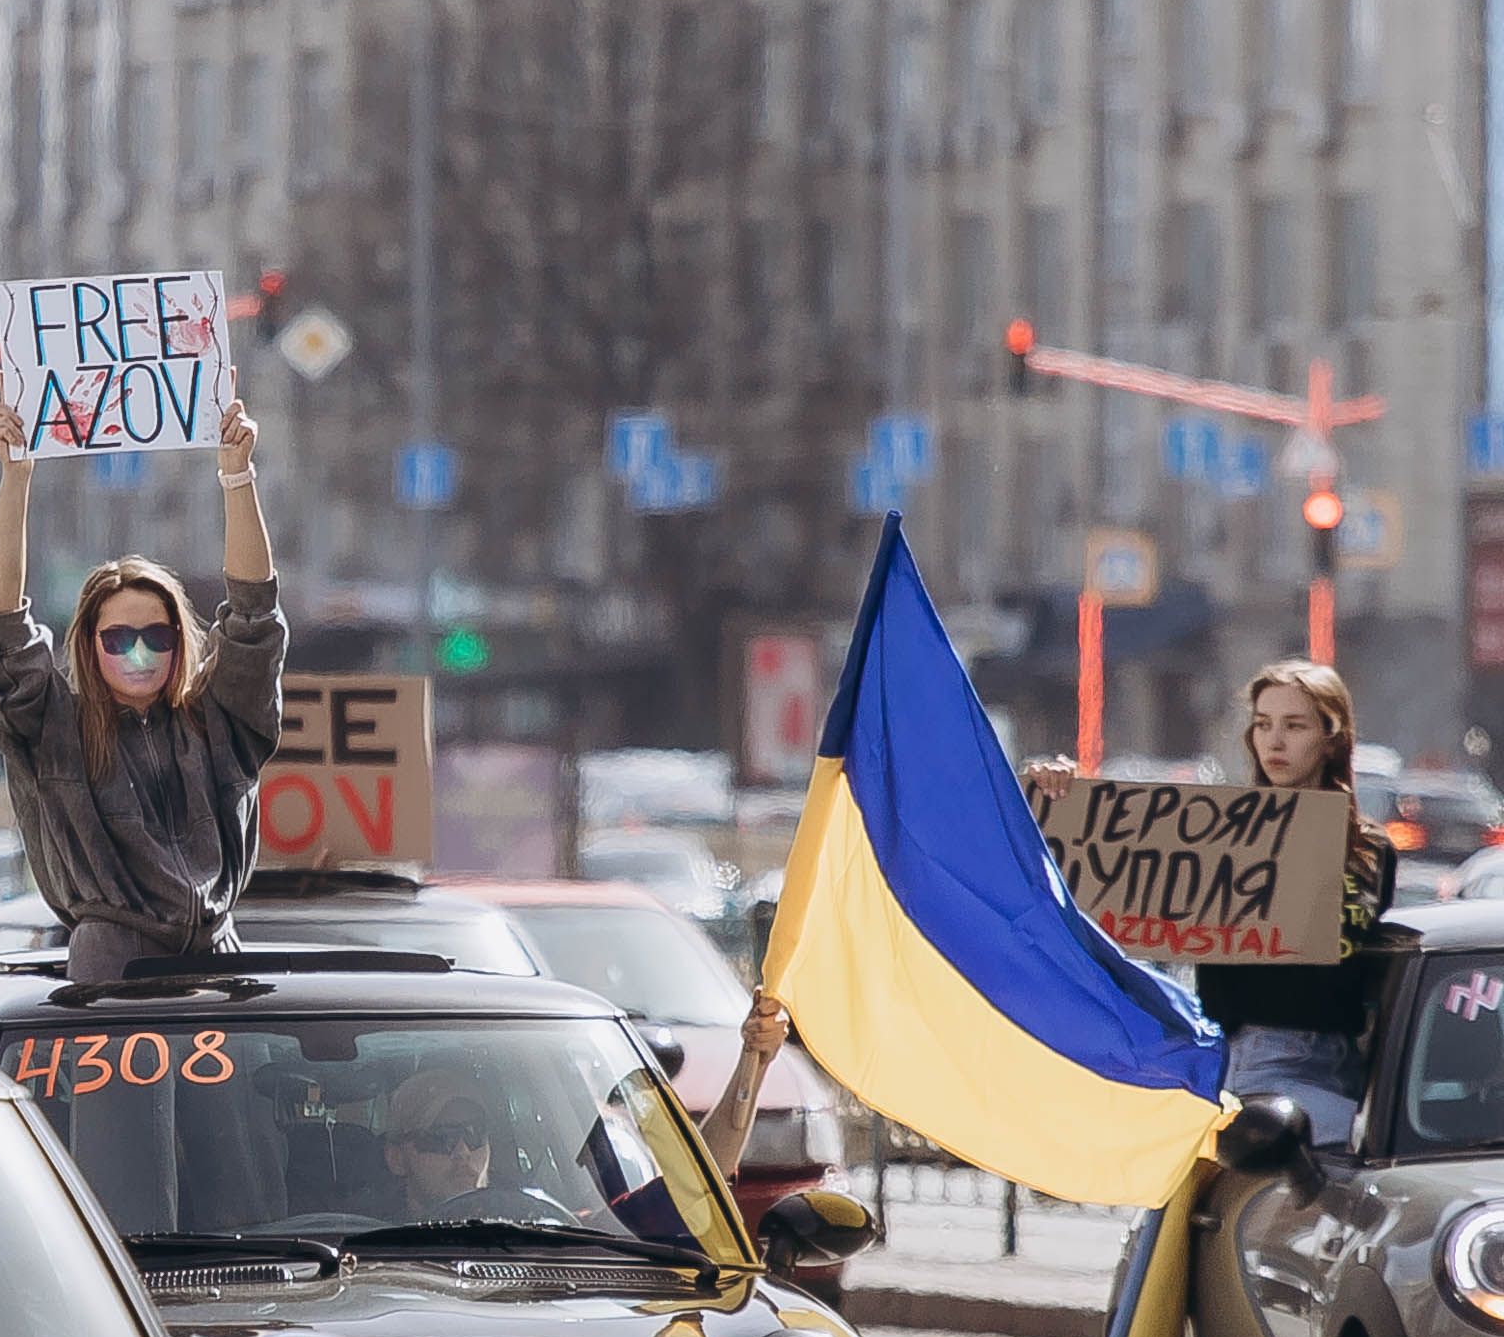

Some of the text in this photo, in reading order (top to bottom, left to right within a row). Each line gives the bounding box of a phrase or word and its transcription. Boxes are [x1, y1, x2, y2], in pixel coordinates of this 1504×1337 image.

[30, 275, 199, 366] FREE
[29, 360, 203, 452] AZOV
[273, 689, 397, 765] EE
[259, 774, 393, 856] OV
[1072, 781, 1300, 859] ГЕРОЯМ
[1047, 837, 1278, 928] ІУПОЛЯ
[15, 1030, 234, 1098] 4308
